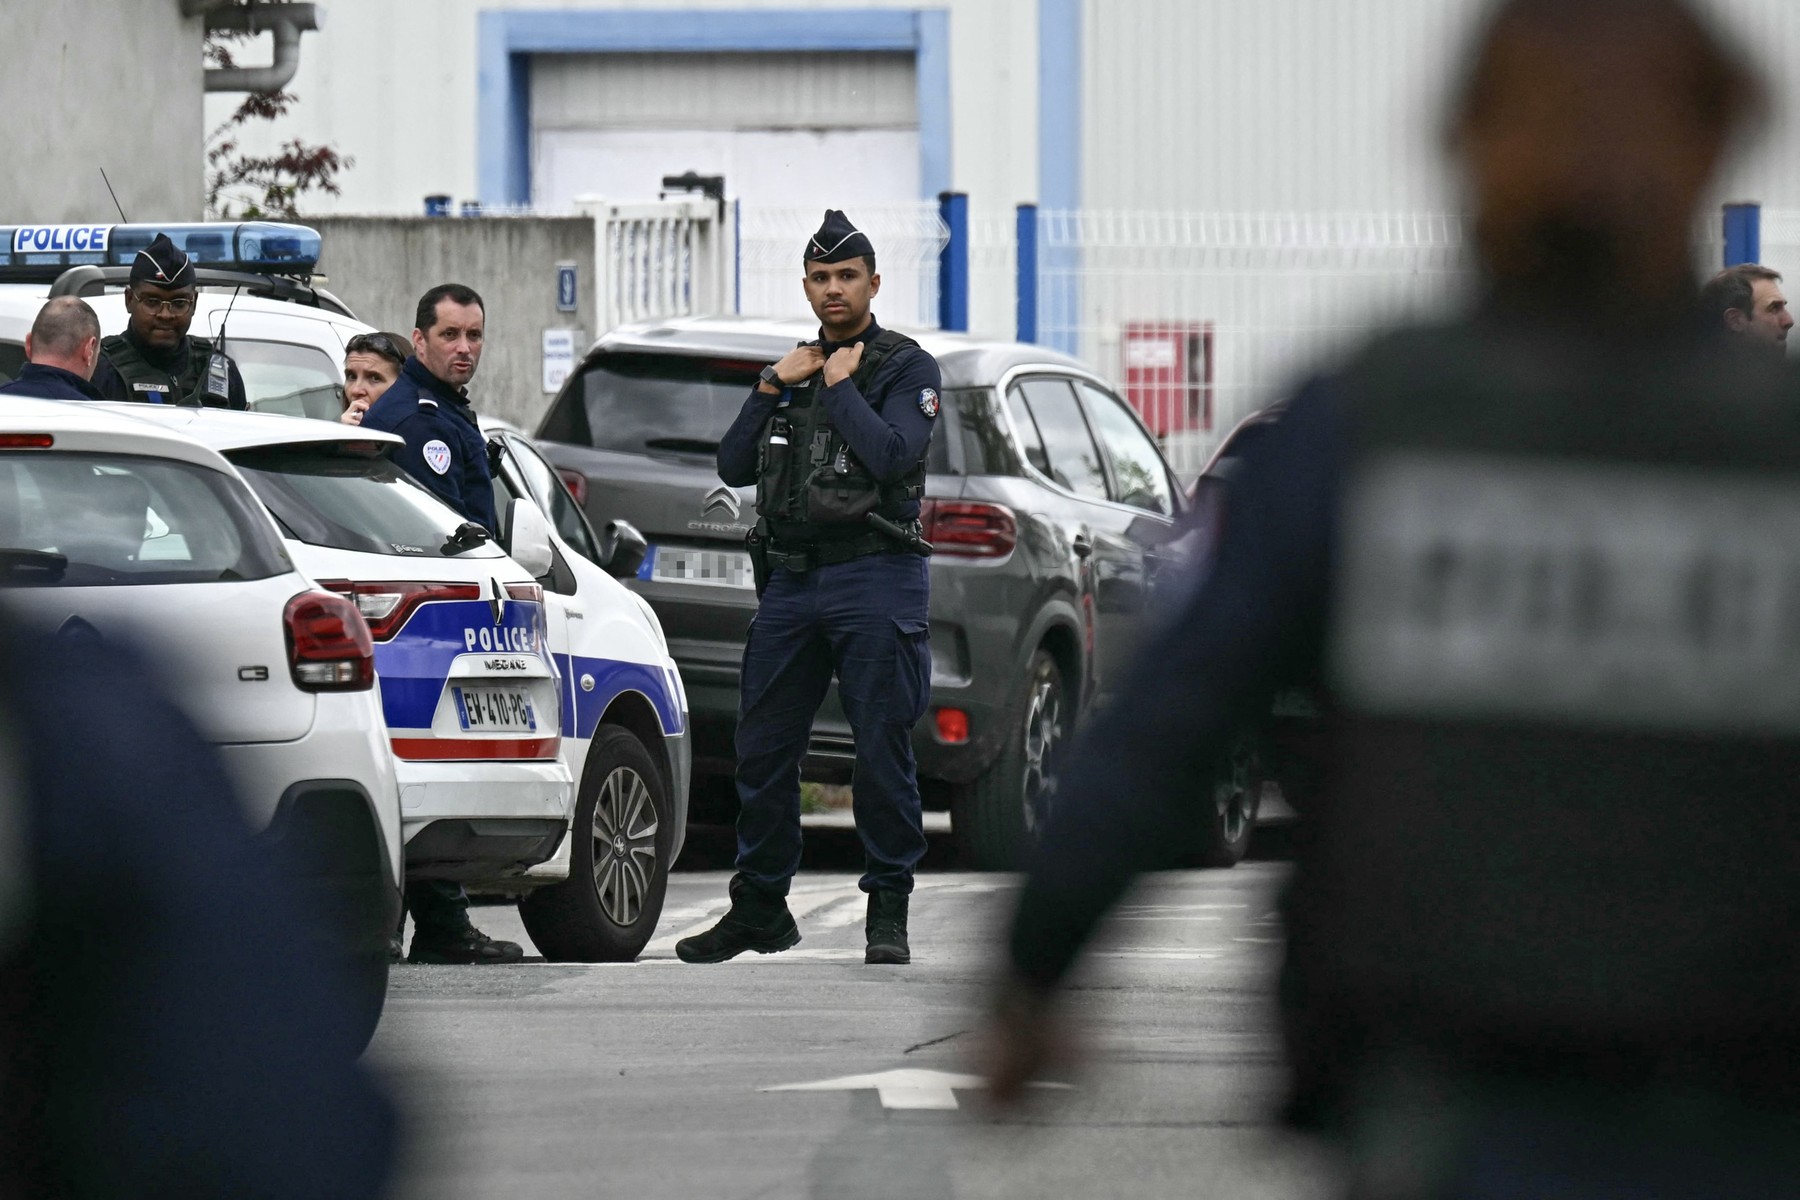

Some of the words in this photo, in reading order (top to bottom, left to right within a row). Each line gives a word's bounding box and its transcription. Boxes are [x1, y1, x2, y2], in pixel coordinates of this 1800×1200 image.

[17, 228, 107, 250] POLICE
[464, 627, 530, 651] POLICE
[237, 665, 269, 681] C3
[484, 659, 527, 671] MEGANE
